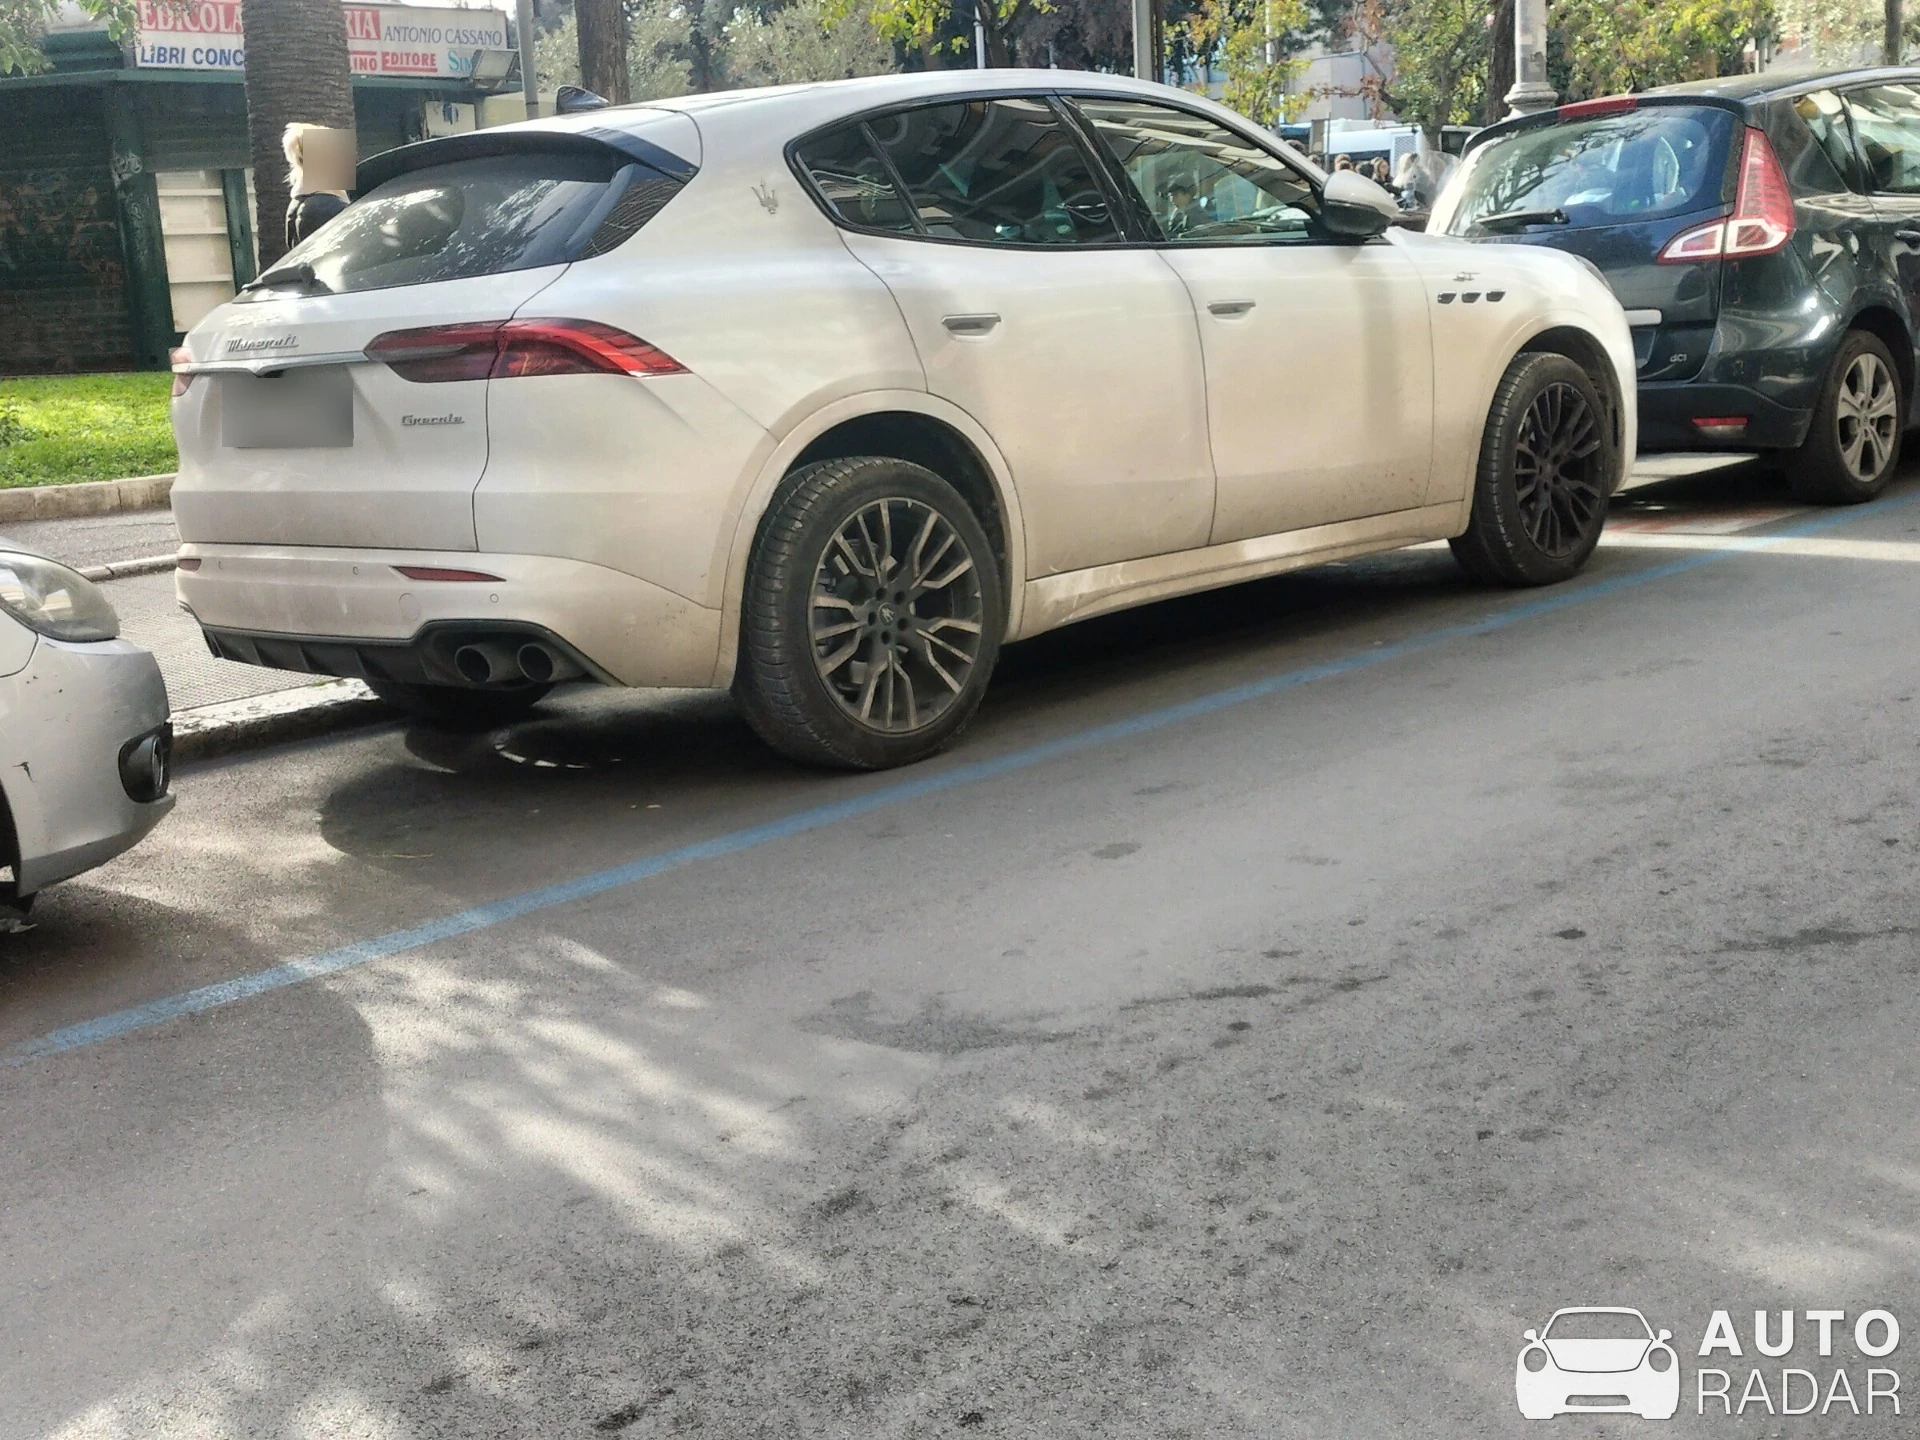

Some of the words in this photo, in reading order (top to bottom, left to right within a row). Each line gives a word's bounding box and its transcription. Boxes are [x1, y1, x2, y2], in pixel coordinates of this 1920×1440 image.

[383, 26, 442, 44] ANTONIO
[445, 28, 502, 46] CASSANO
[141, 46, 186, 64] LIBRI
[350, 57, 377, 71] INO
[381, 51, 438, 72] EDITORE
[227, 333, 299, 353] Maserati
[401, 413, 466, 427] Grecale
